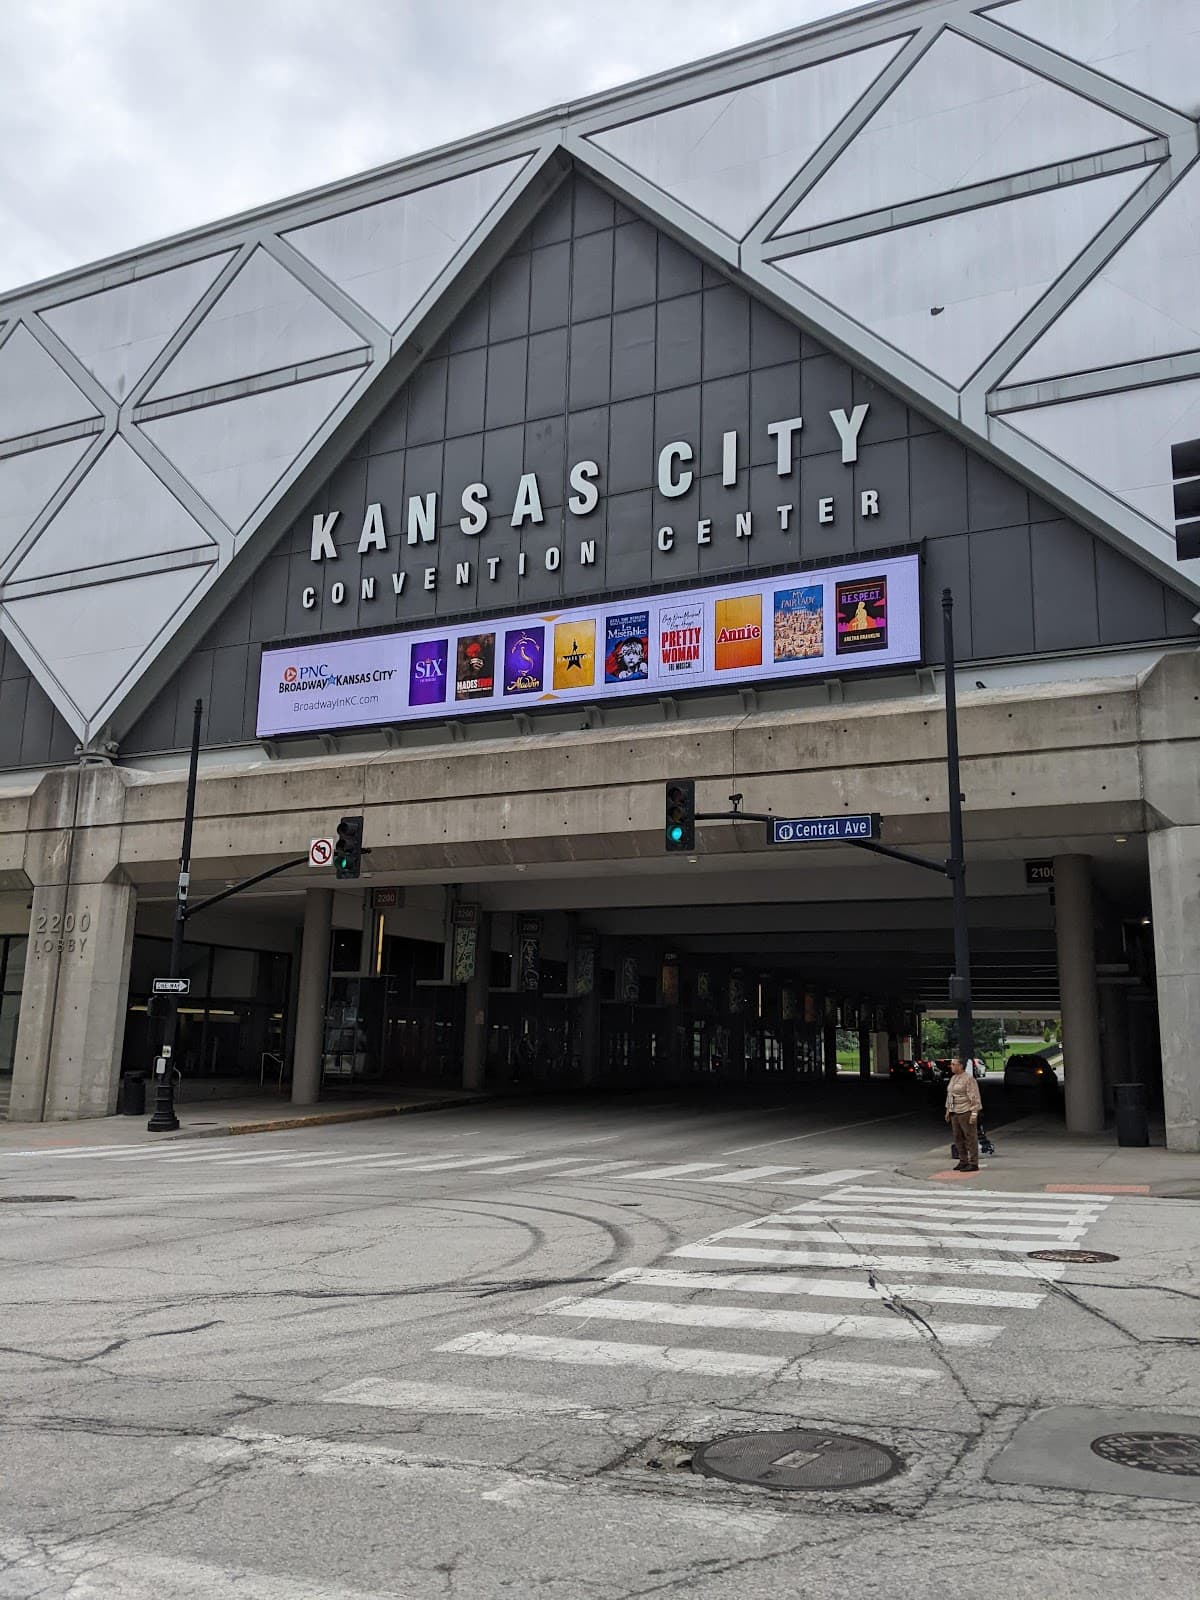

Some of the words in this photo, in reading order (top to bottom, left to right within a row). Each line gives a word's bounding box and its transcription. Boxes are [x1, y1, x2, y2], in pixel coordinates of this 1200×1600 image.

[310, 460, 600, 562] KANSAS
[658, 403, 870, 498] CITY
[302, 539, 596, 610] CONVENTION
[658, 489, 880, 552] CENTER
[661, 627, 702, 648] PRETTY
[716, 625, 761, 643] Annie
[661, 645, 700, 664] WOMAN
[300, 664, 328, 679] PNC
[279, 679, 328, 693] BROADWAY
[335, 672, 371, 686] KANSAS
[796, 821, 840, 837] Central
[845, 821, 867, 834] Ave
[377, 894, 395, 902] 2200
[36, 912, 92, 934] 2200
[34, 937, 88, 954] LOBBY
